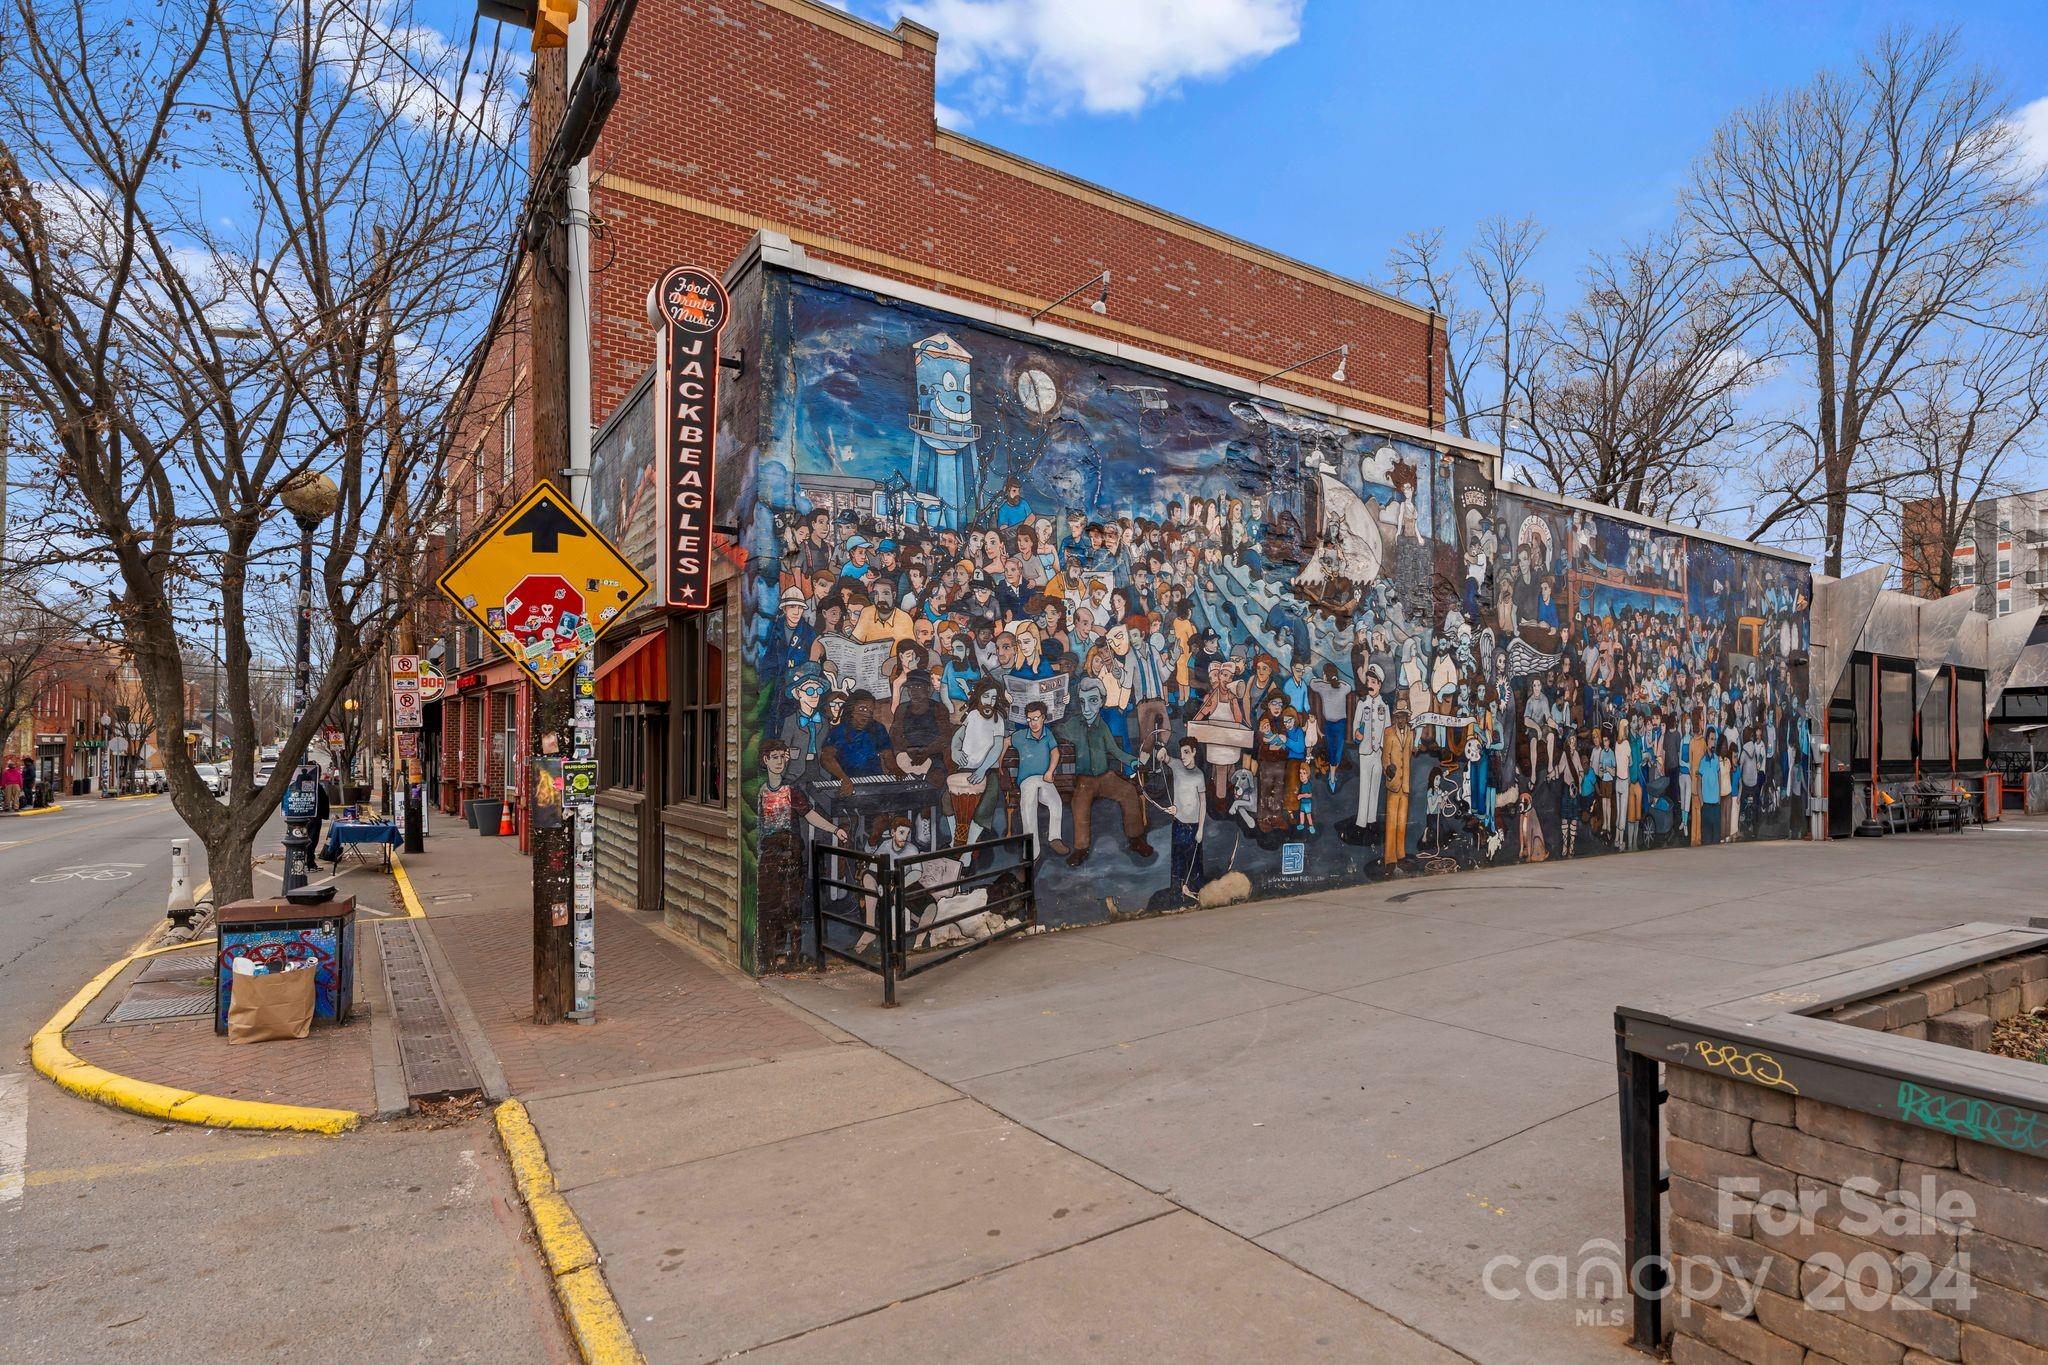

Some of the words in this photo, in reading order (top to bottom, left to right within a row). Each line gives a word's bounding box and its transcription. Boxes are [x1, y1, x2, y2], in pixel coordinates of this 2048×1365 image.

[675, 277, 711, 296] Food
[668, 291, 715, 312] Drinks
[670, 306, 714, 327] Music
[676, 339, 704, 575] JACKBEAGLES
[1695, 1041, 1799, 1095] BBQ
